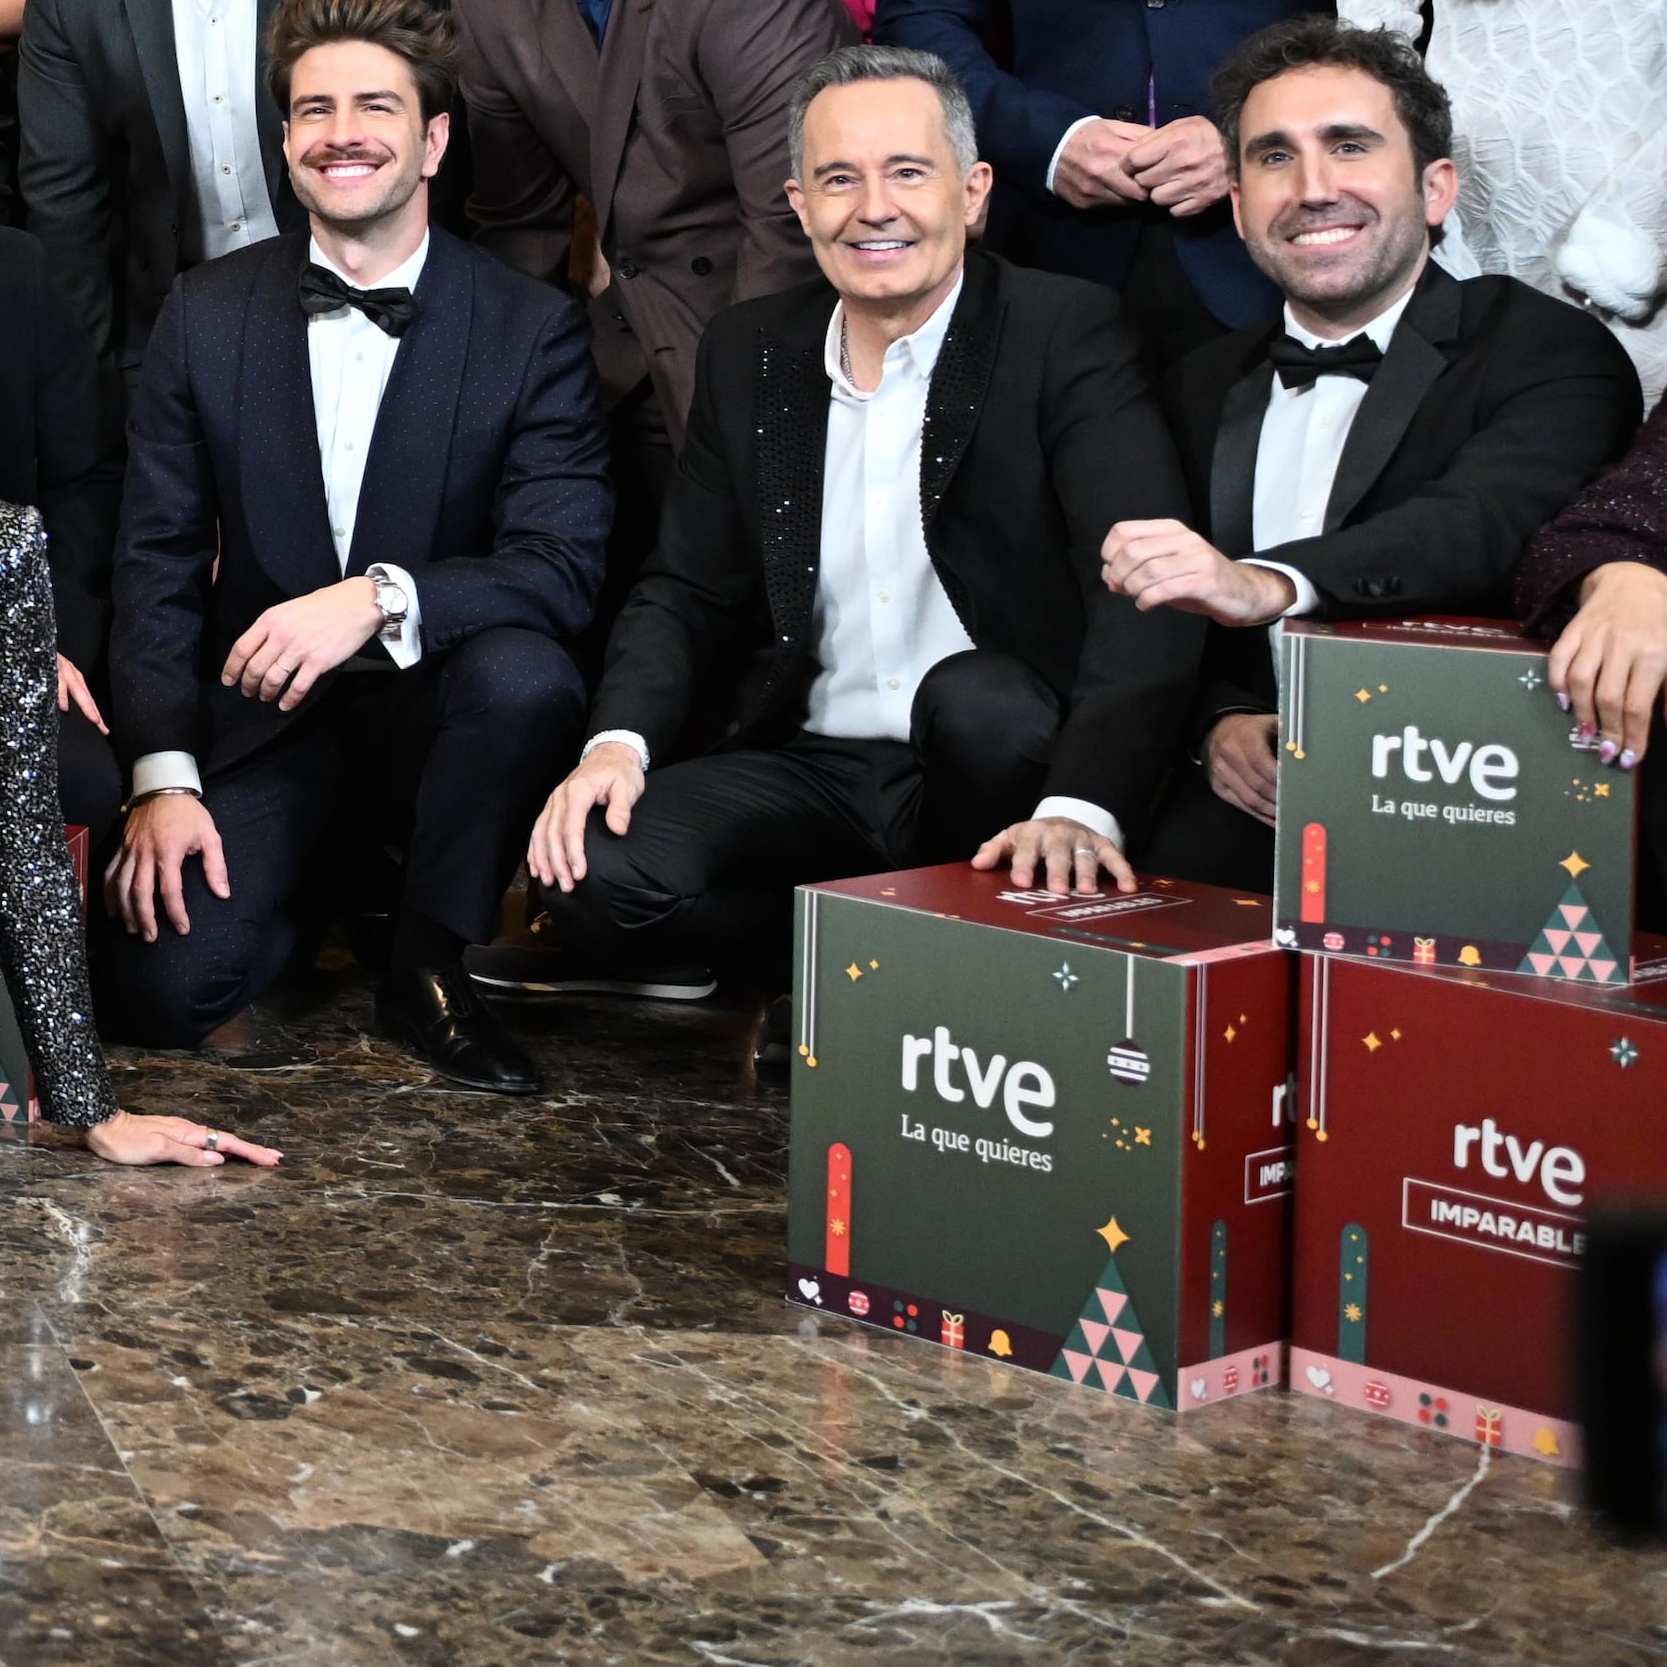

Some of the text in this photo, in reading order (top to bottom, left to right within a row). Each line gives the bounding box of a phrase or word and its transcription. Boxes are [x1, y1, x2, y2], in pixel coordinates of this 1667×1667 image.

[1371, 725, 1519, 801] rtve
[1371, 794, 1516, 825] La que quieres
[902, 1025, 1056, 1137] rtve
[901, 1113, 1053, 1173] La que quieres
[1454, 1118, 1586, 1206] rtve
[1431, 1199, 1588, 1255] IMPARABLE
